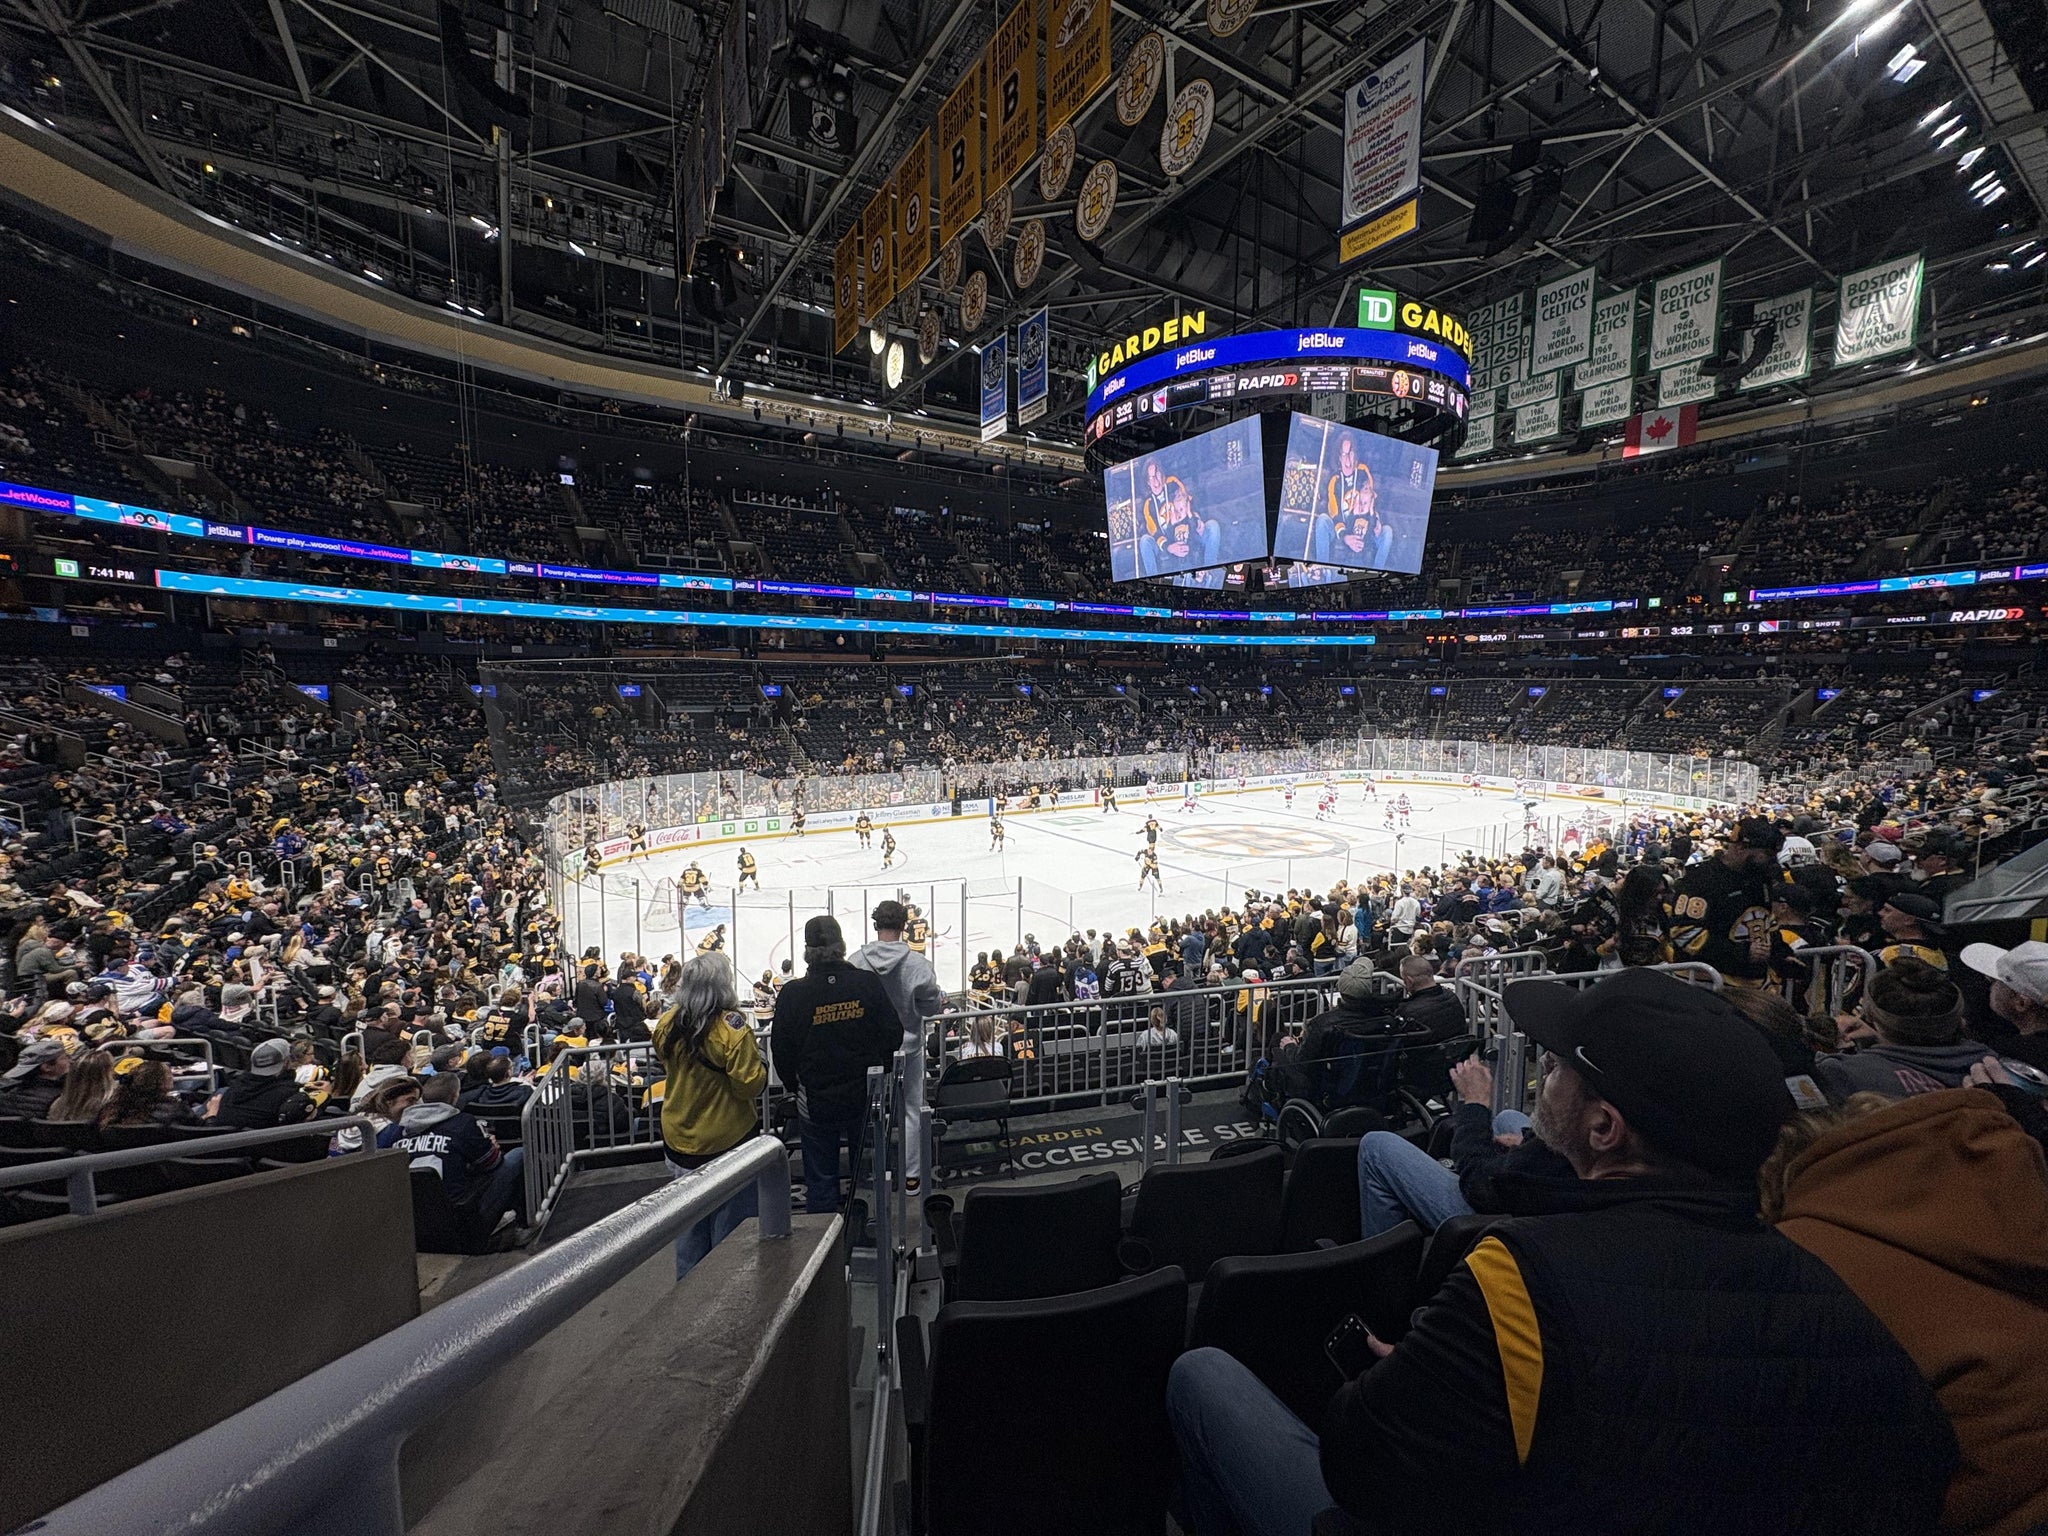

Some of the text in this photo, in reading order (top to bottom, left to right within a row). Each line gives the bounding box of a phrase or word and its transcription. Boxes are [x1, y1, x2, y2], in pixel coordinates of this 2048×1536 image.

[993, 22, 1030, 88] BRUINS
[1054, 27, 1101, 89] STANLEY CUP
[1053, 47, 1101, 108] CHAMPIONS
[1166, 84, 1209, 130] ZDENO CHARA
[943, 96, 975, 150] BRUINS
[1179, 120, 1193, 139] 33
[1368, 122, 1394, 143] UCONN
[1660, 272, 1715, 301] BOSTON
[1847, 265, 1912, 297] BOSTON
[1541, 278, 1589, 308] BOSTON
[1849, 281, 1908, 310] CELTICS
[1542, 295, 1586, 322] CELTICS
[1661, 288, 1711, 315] CELTICS
[1469, 296, 1519, 330] 22 14
[1362, 295, 1473, 364] TD GARDEN
[1497, 319, 1518, 341] 15
[1552, 326, 1571, 339] 2008
[1673, 319, 1694, 333] 1968
[1855, 323, 1895, 340] WORLD
[1098, 310, 1206, 376] GARDEN
[1297, 333, 1345, 352] jetBlue
[1547, 335, 1576, 349] WORLD
[1666, 329, 1699, 346] WORLD
[1842, 330, 1907, 353] CHAMPIONS
[1407, 341, 1438, 362] jetBlue
[1494, 339, 1518, 365] 25
[1538, 342, 1585, 365] CHAMPIONS
[1654, 336, 1711, 360] CHAMPIONS
[1175, 348, 1216, 370] jetBlue
[1589, 352, 1618, 368] WORLD
[1360, 368, 1385, 376] PENALTIES
[1499, 366, 1511, 383] 6
[1578, 359, 1628, 381] CHAMPIONS
[1103, 376, 1126, 401] jetBlue
[1176, 381, 1200, 391] PENALTIES
[1238, 373, 1298, 391] RAPID7
[1412, 379, 1420, 394] 0
[1673, 373, 1702, 388] WORLD
[1428, 380, 1445, 398] 3:32
[1511, 383, 1554, 400] CHAMPIONS
[1662, 380, 1712, 400] CHAMPIONS
[1140, 398, 1149, 412] 0
[1449, 392, 1455, 406] 0
[1594, 395, 1620, 408] WORLD
[1116, 402, 1133, 418] 3:32
[1585, 402, 1628, 419] CHAMPIONS
[1104, 415, 1111, 428] 0
[1517, 420, 1556, 436] CHAMPIONS
[1525, 415, 1549, 426] WORLD
[208, 524, 242, 538] jetBlue
[257, 532, 286, 544] Power
[57, 561, 76, 574] TD
[88, 566, 135, 580] 7:41 PM
[509, 563, 534, 573] jetBlue
[544, 568, 564, 576] Power
[1978, 570, 2011, 580] jetBlue
[2022, 567, 2044, 576] Power
[735, 581, 755, 589] jetBlue
[1887, 615, 1926, 623] PENALTIES
[1949, 608, 2024, 622] RAPID7
[1643, 628, 1650, 636] 0
[1671, 627, 1693, 635] 3:32
[1742, 623, 1750, 632] 0
[1803, 621, 1810, 629] 0
[1479, 634, 1507, 642] $25,470
[874, 808, 921, 820] Jeffrey Glassman
[723, 824, 734, 834] TD
[746, 822, 757, 832] TD
[768, 820, 779, 830] TD
[604, 841, 631, 856] ESPN
[815, 1000, 860, 1015] BOSTON
[812, 1007, 865, 1026] BRUINS
[484, 1022, 509, 1042] 37
[1013, 1039, 1034, 1052] NELY
[999, 1126, 1104, 1148] GARDEN
